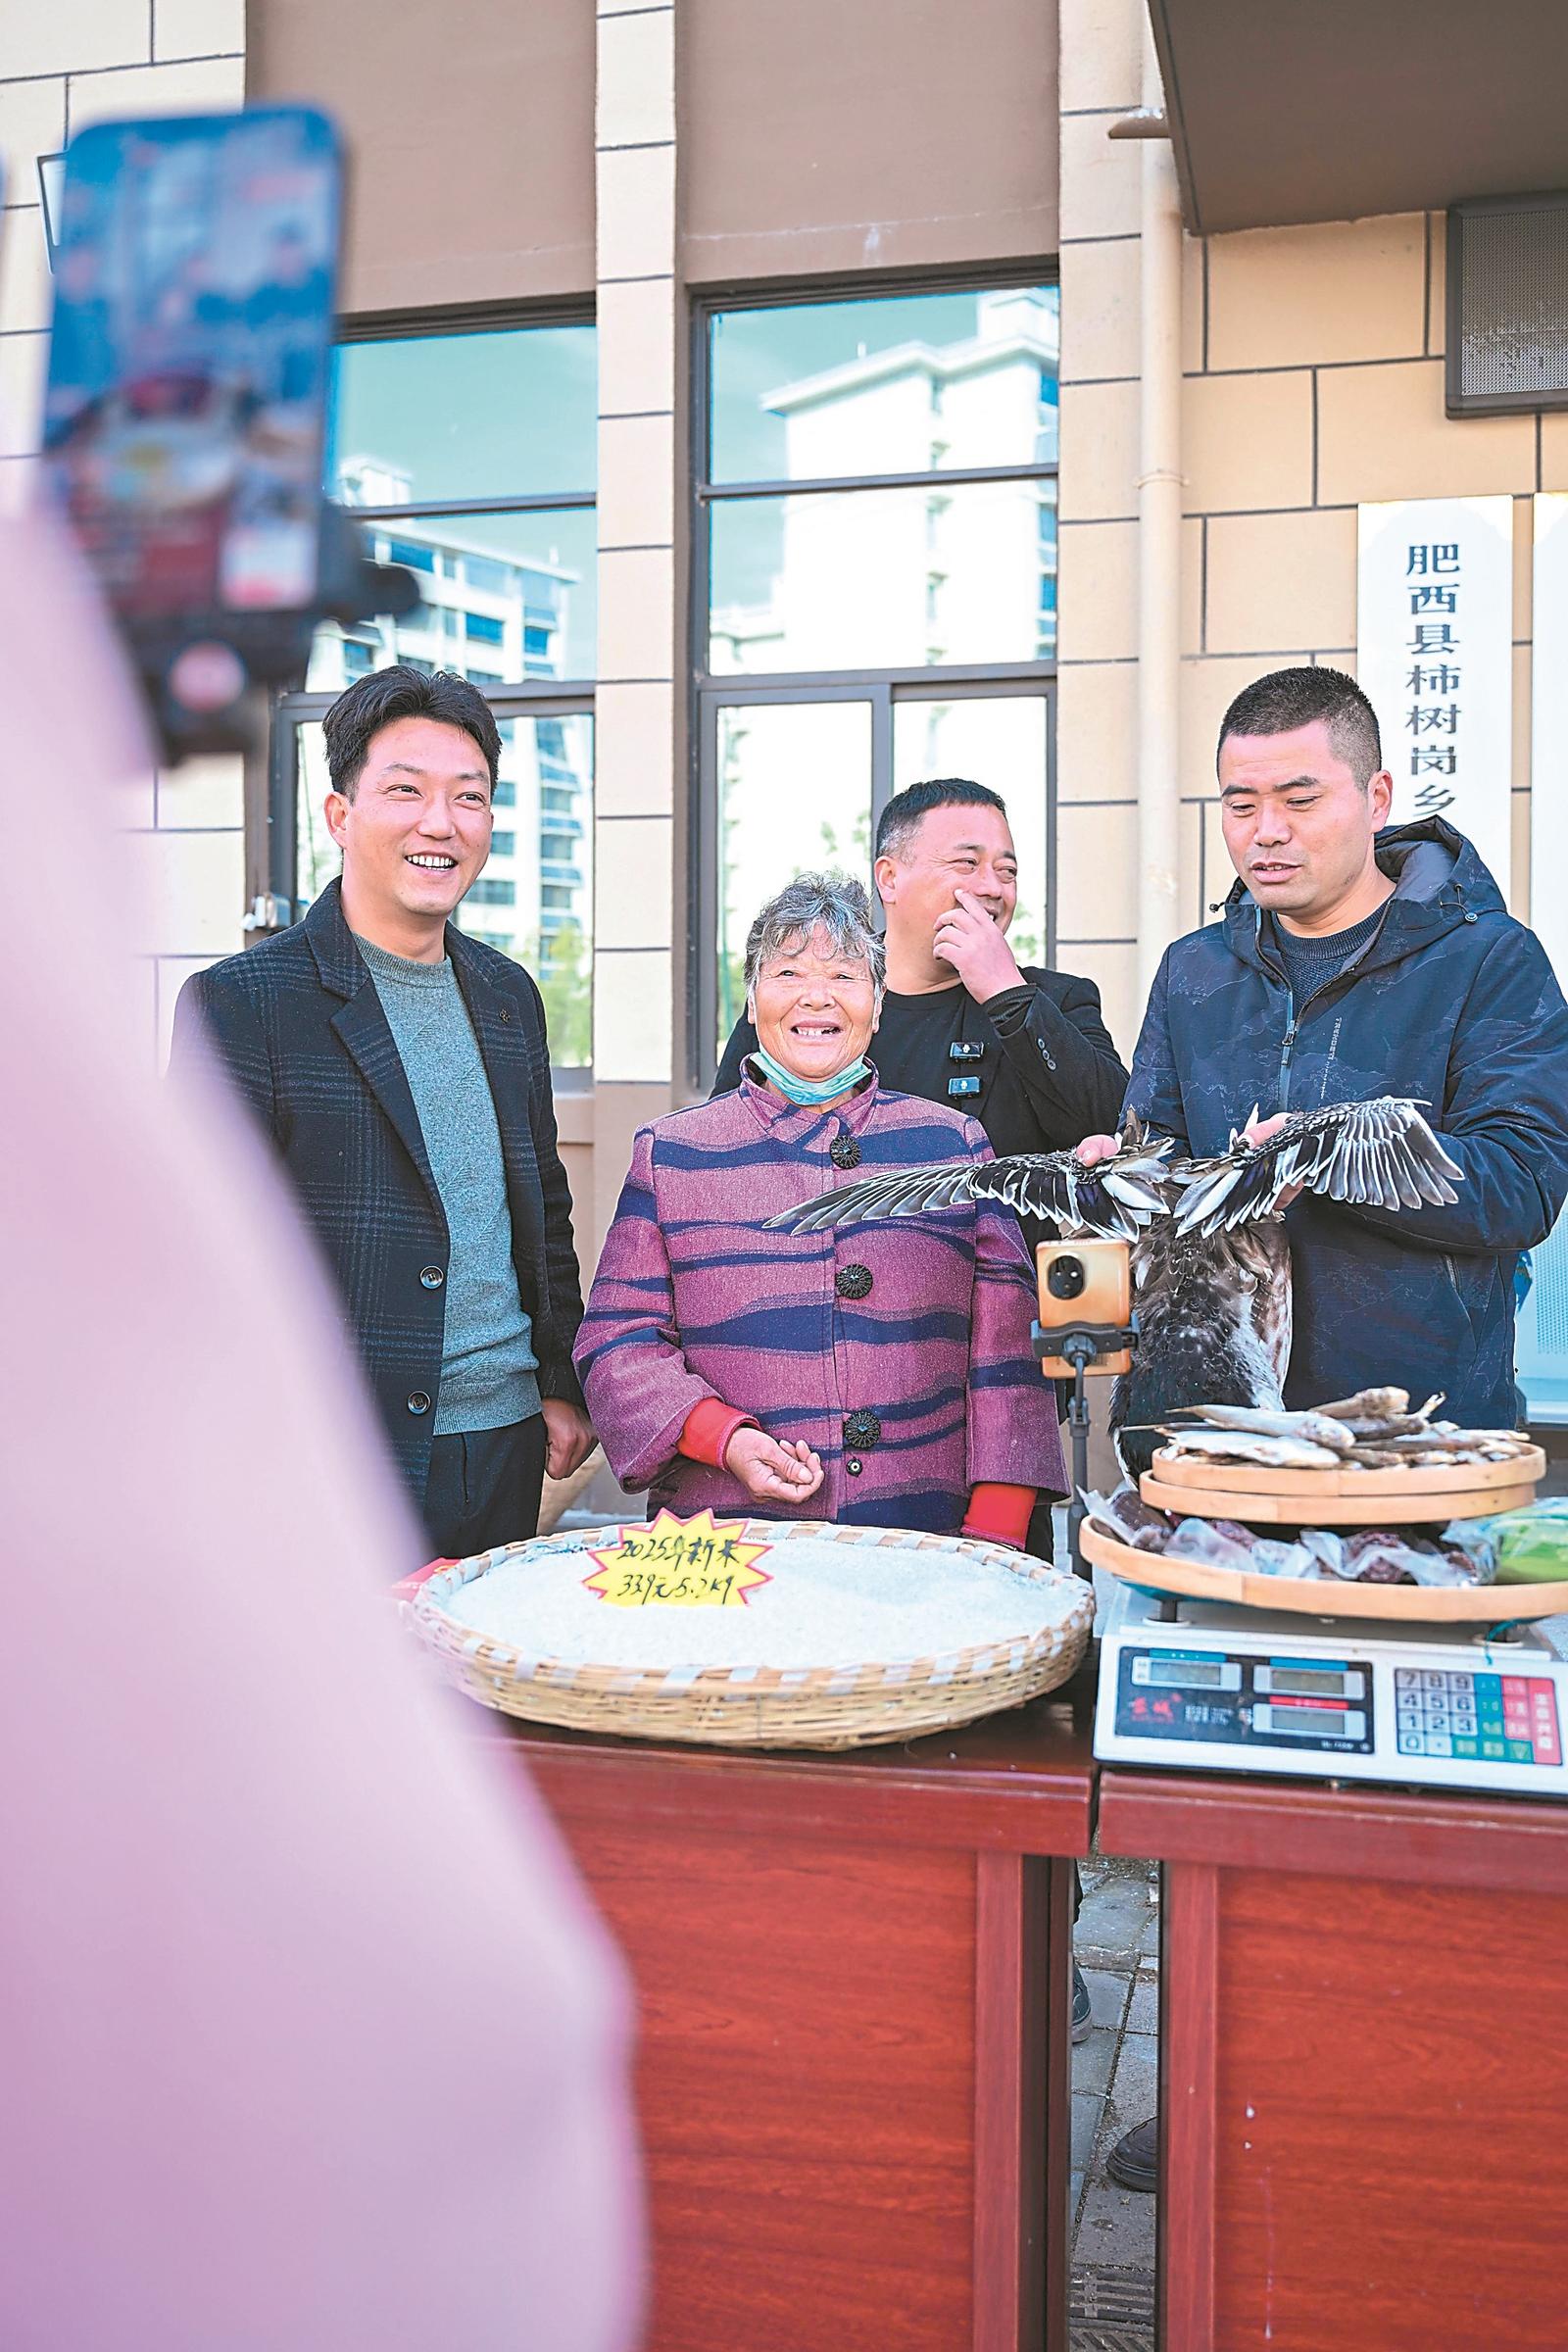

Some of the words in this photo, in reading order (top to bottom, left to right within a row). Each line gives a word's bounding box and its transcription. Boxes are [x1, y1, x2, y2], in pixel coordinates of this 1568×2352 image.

[1404, 543, 1462, 816] 肥西县柿树岗乡
[1401, 1671, 1416, 1686] 7
[1429, 1673, 1443, 1689] 8
[1403, 1693, 1418, 1707] 4
[1430, 1695, 1444, 1709] 5
[1456, 1696, 1470, 1710] 6
[1431, 1716, 1445, 1730] 2
[1457, 1718, 1471, 1733] 3
